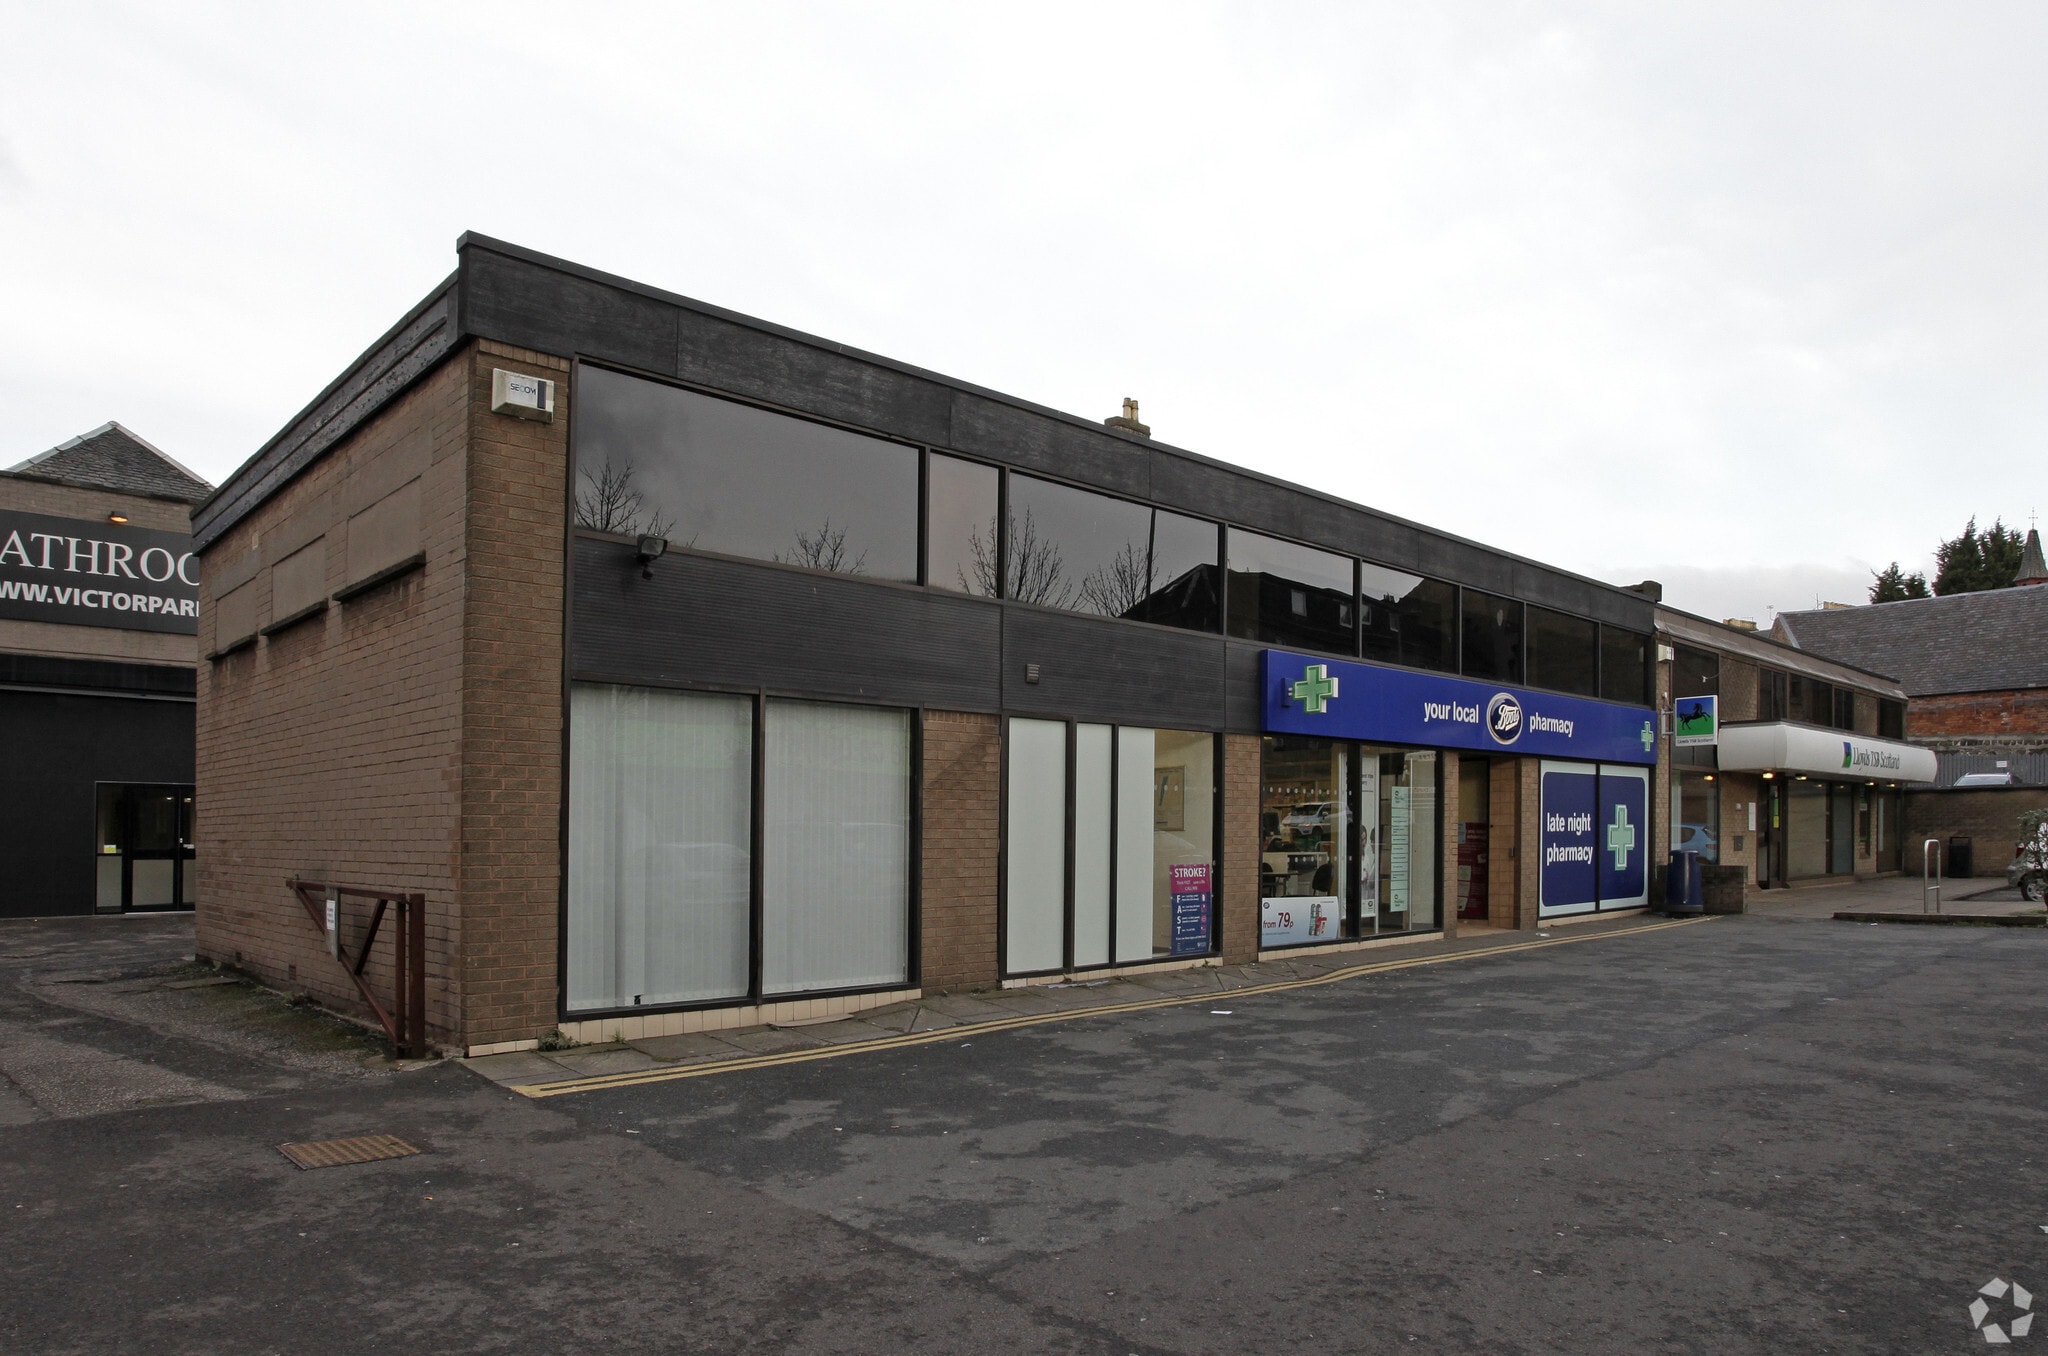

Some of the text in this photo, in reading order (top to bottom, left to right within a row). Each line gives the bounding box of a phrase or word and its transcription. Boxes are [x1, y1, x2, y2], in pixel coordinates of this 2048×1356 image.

[510, 382, 537, 395] SECOM
[0, 580, 200, 618] WW.VICTORPAR
[1424, 701, 1574, 738] your local Boots pharmacy
[1547, 812, 1591, 836] late night
[1546, 842, 1593, 867] pharmacy
[1174, 867, 1206, 878] STROKE?
[1176, 894, 1181, 903] F
[1177, 905, 1182, 914] A
[1176, 915, 1181, 925] S
[1263, 911, 1294, 929] from 79p
[1176, 926, 1181, 935] T
